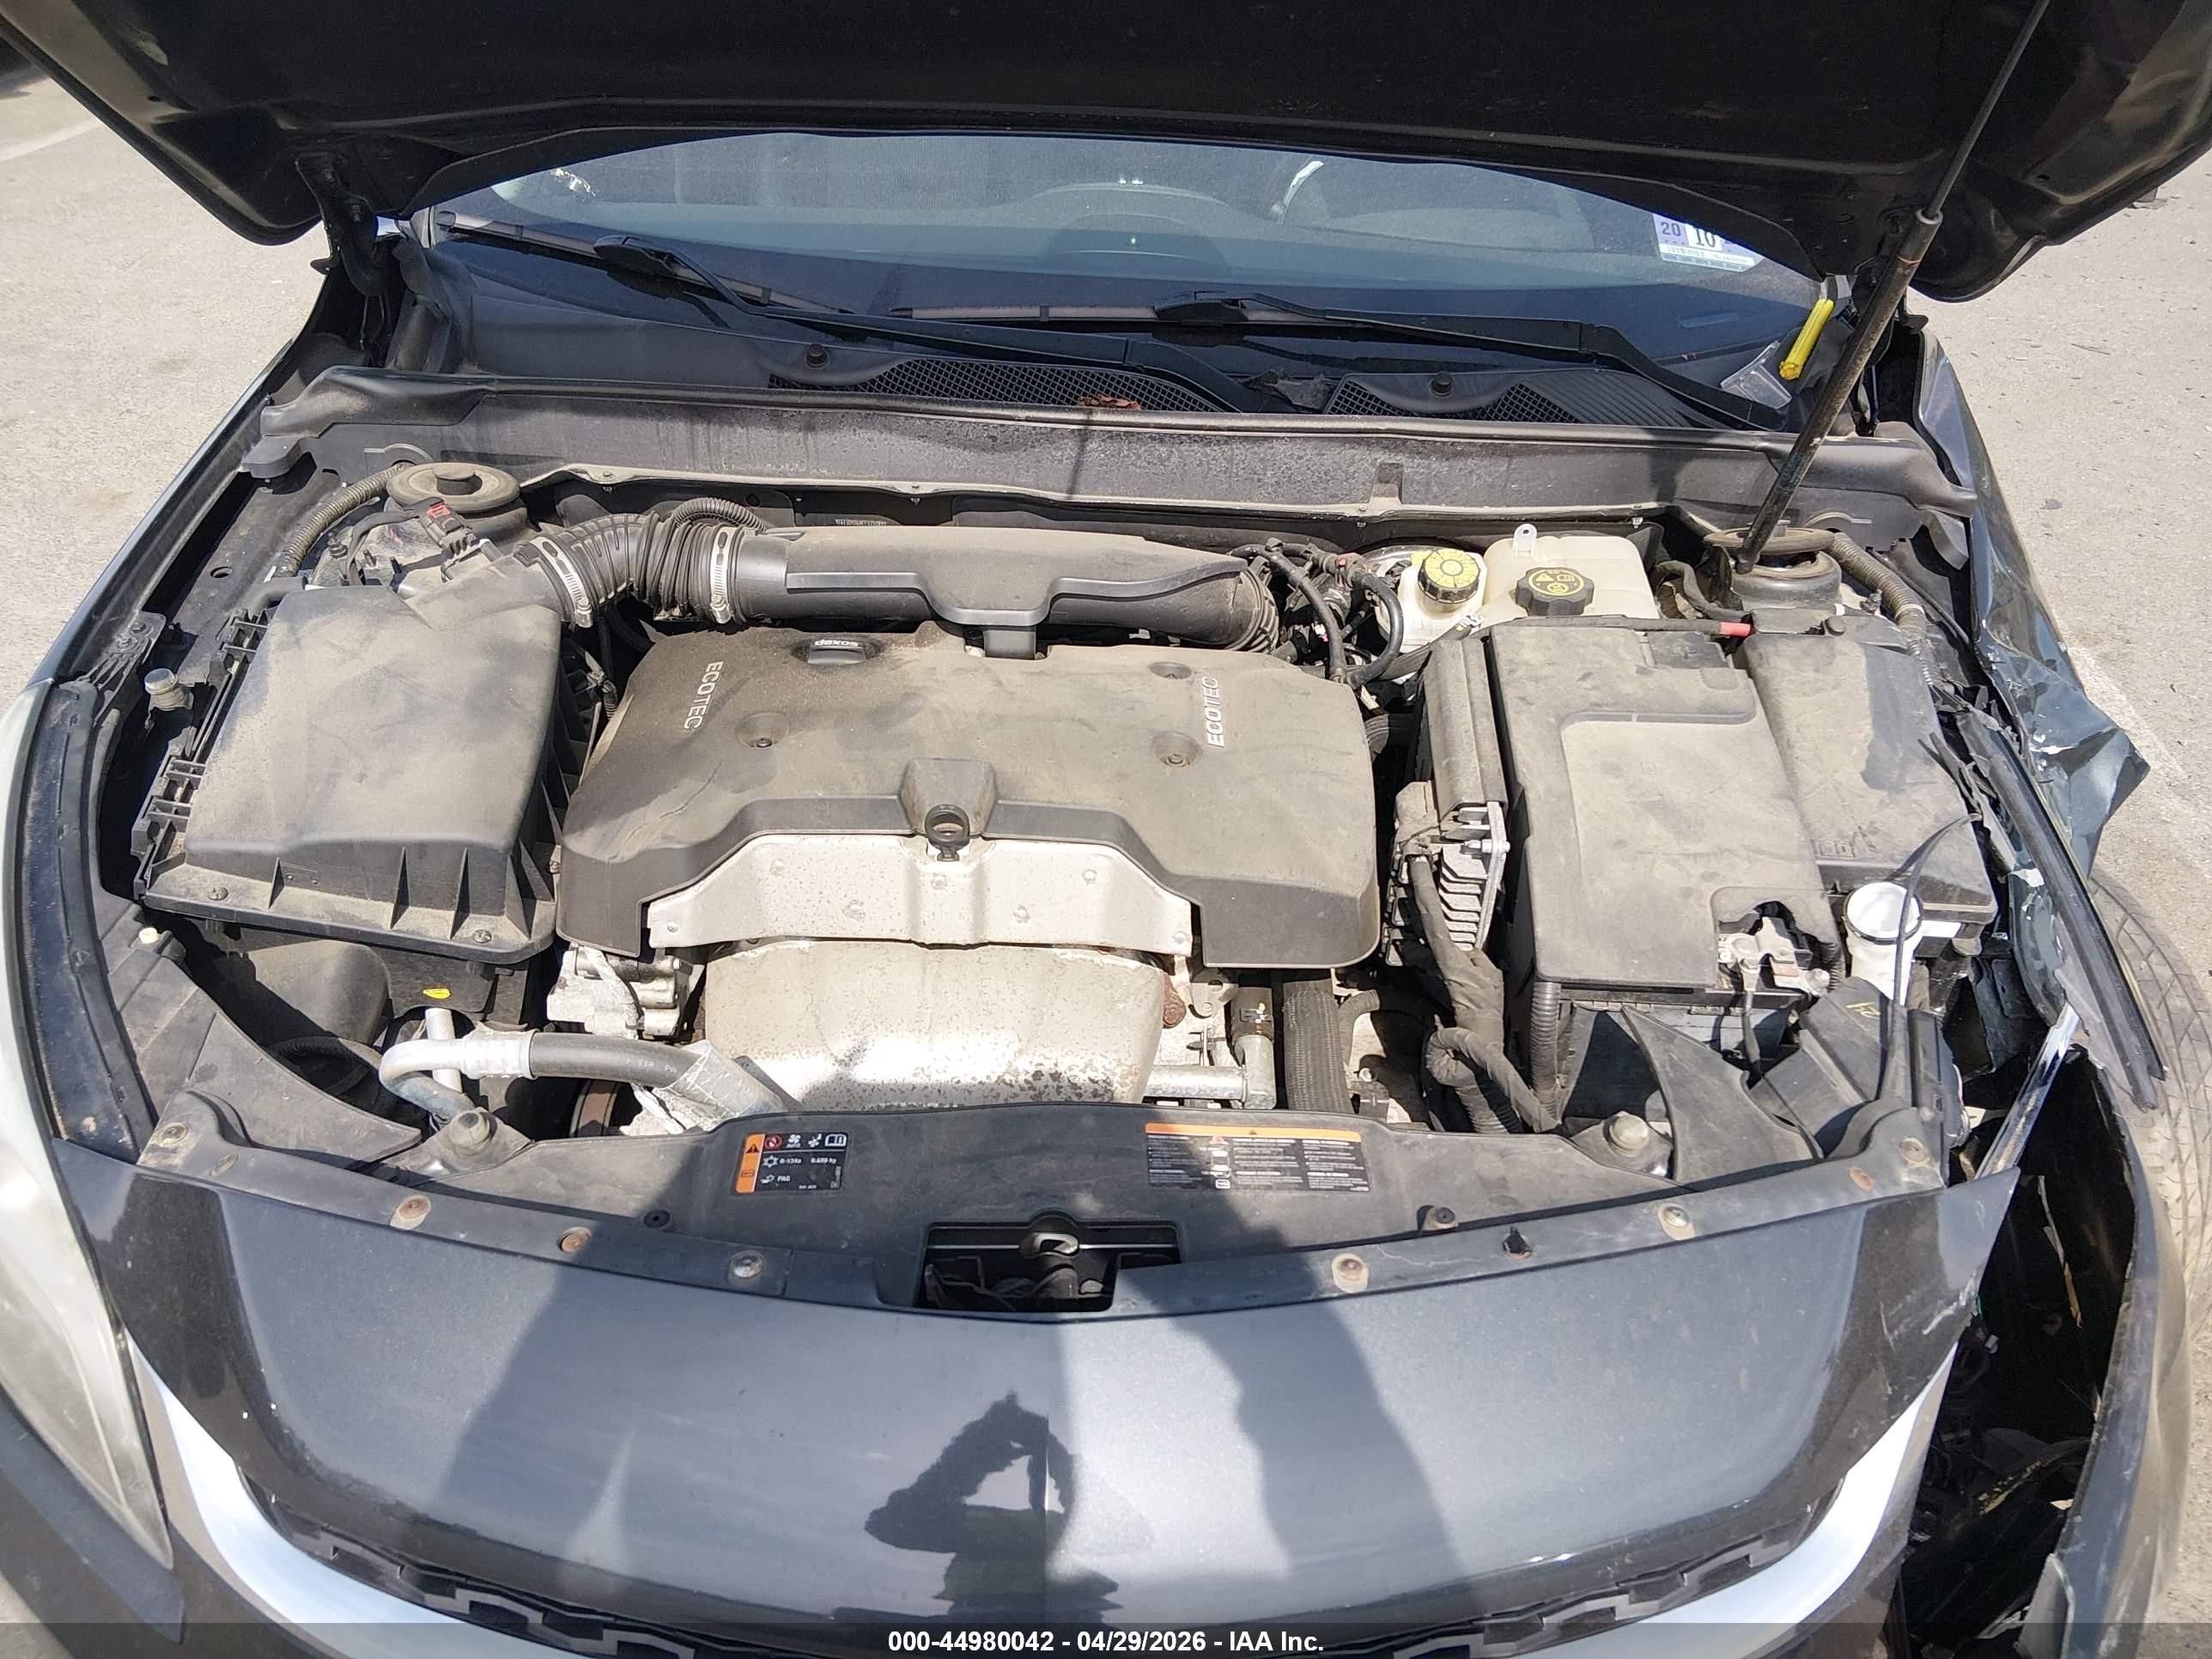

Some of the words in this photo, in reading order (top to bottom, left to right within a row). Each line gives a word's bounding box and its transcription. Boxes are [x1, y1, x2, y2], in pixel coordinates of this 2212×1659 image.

[1661, 222, 1681, 236] 20
[684, 660, 725, 730] ECOTEC
[1201, 676, 1225, 748] ECOTEC
